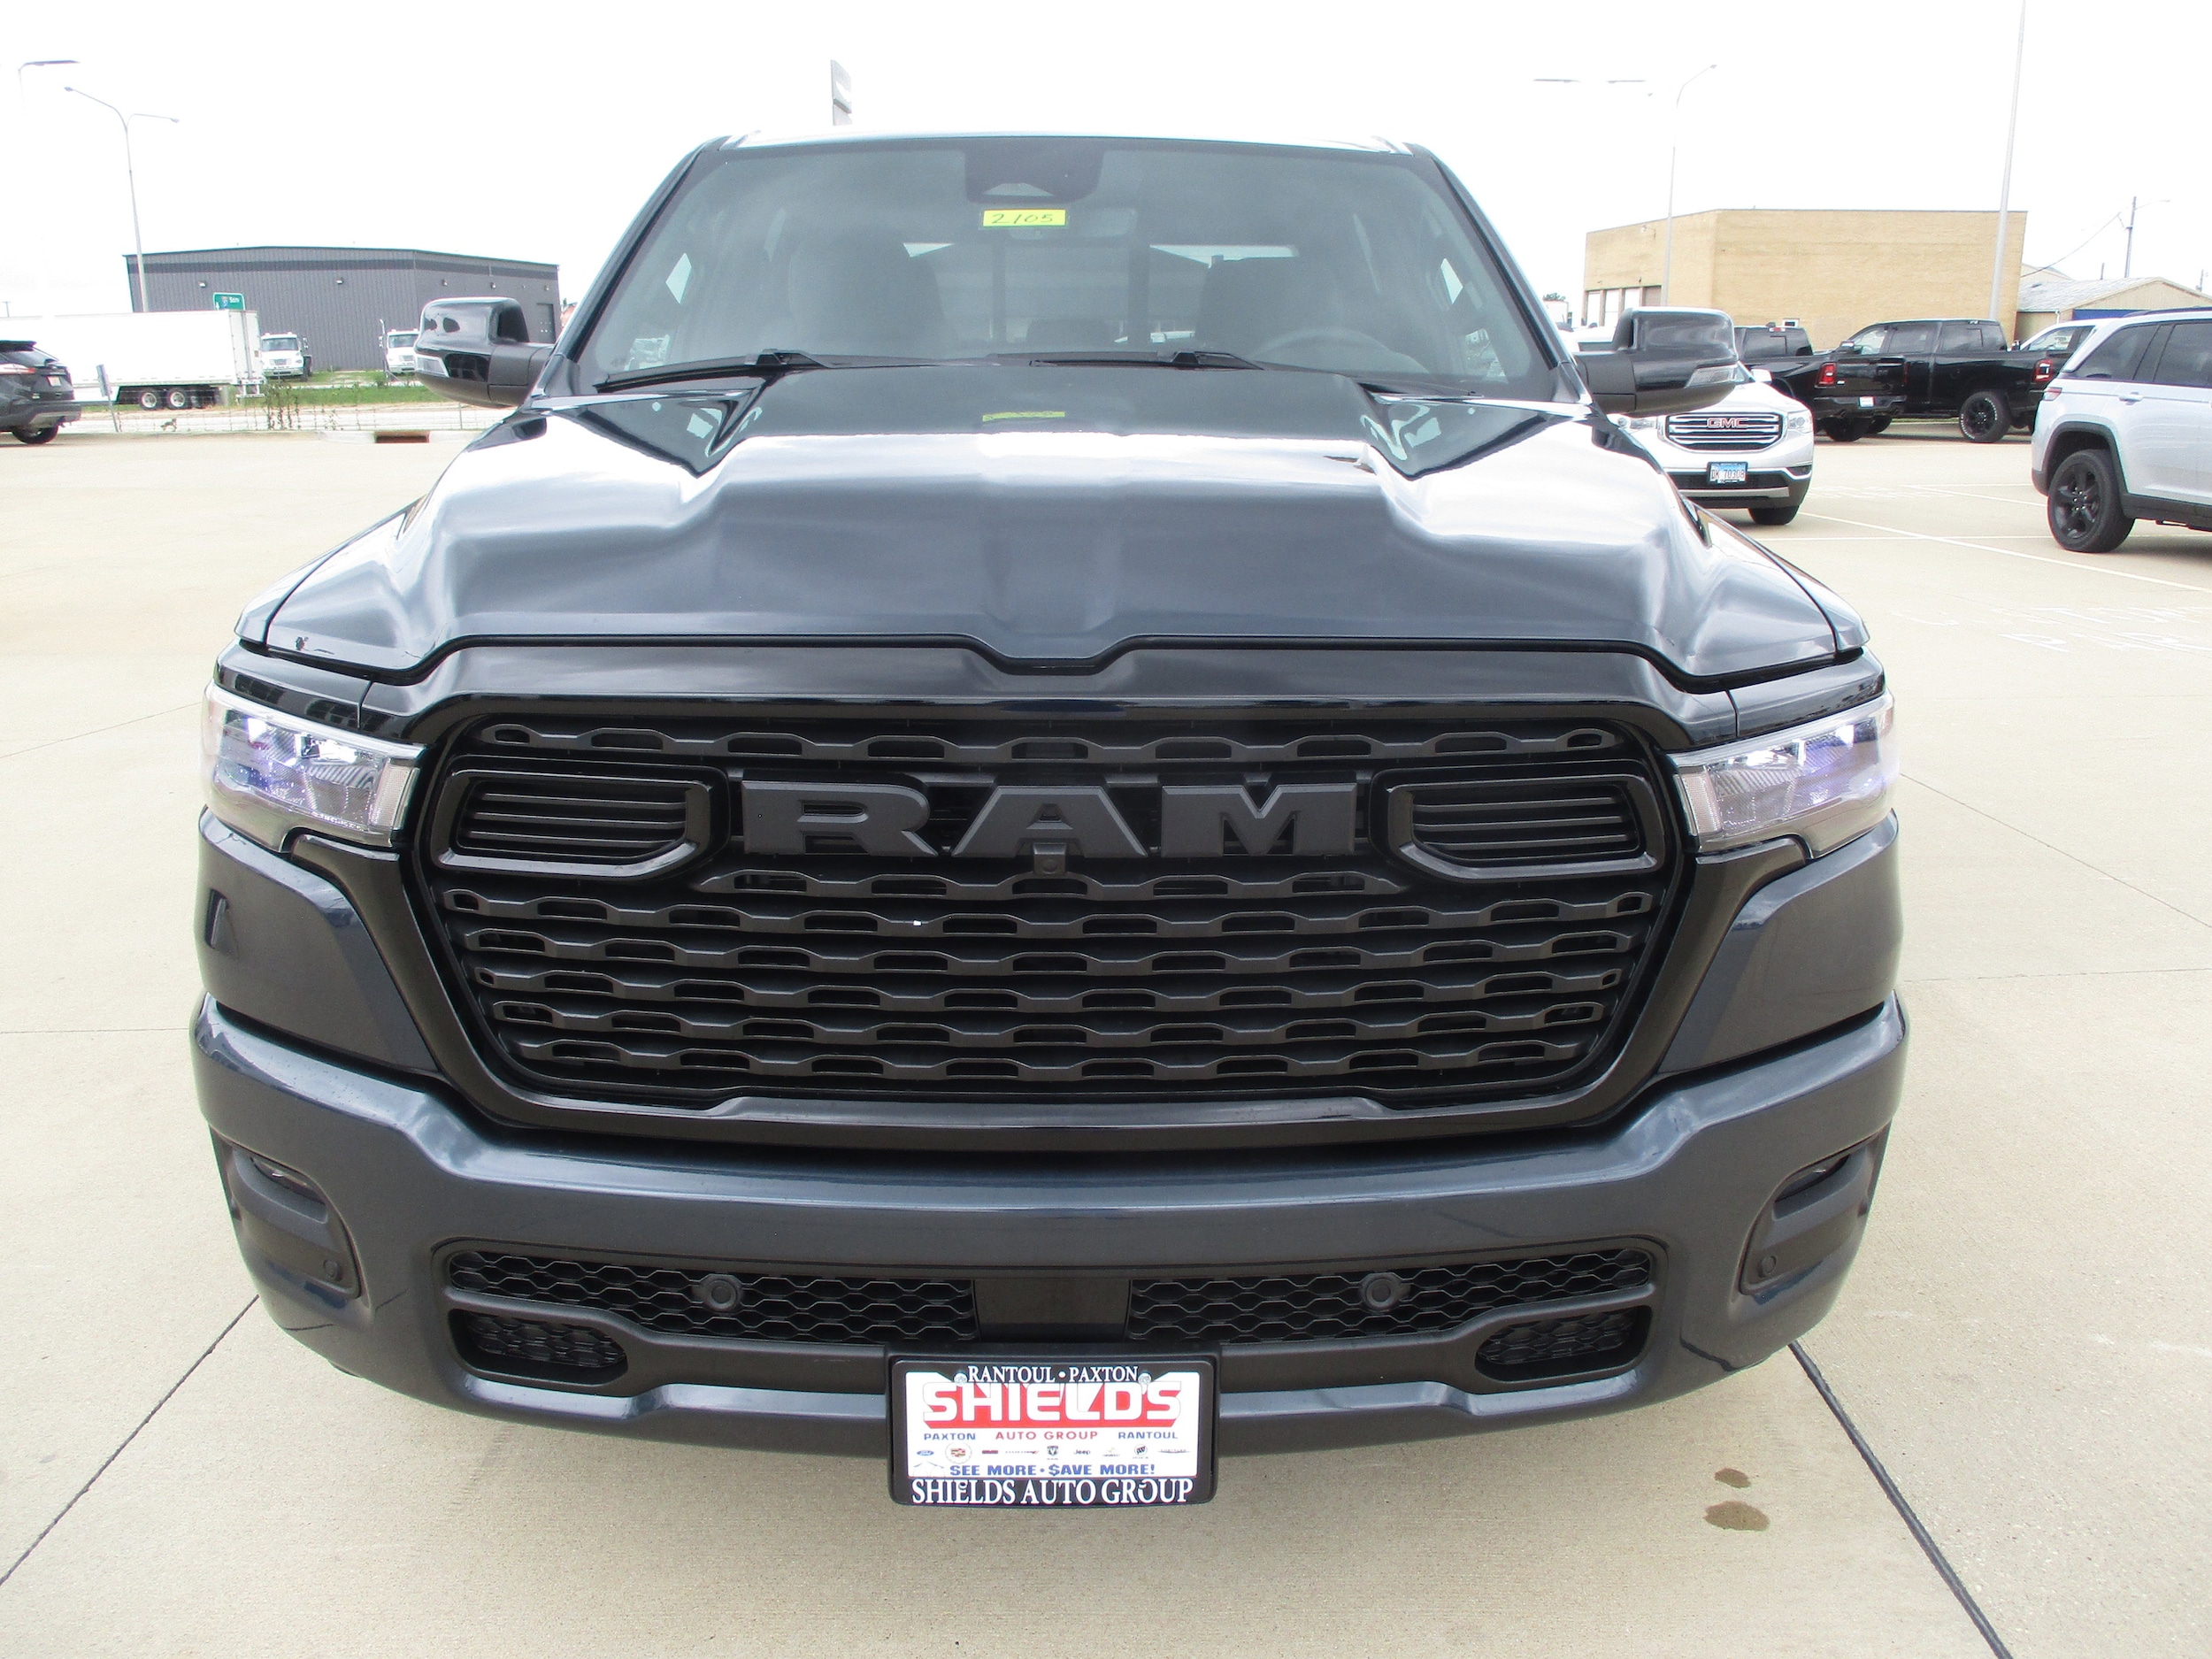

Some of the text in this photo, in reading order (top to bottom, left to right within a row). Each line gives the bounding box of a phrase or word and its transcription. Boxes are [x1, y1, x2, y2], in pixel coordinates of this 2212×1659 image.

[991, 213, 1053, 225] 2105
[1707, 417, 1748, 428] GMC
[742, 777, 1357, 857] RAM
[967, 1365, 1138, 1383] RANTOUL PAXTON
[922, 1381, 1182, 1428] SHIELDS
[995, 1431, 1098, 1440] AUTO GROUP
[1118, 1431, 1179, 1440] RANTOUL
[949, 1463, 1155, 1477] SEE MORE $AVE MORE!
[912, 1478, 1194, 1504] SHIELDS AUTO GROUP
